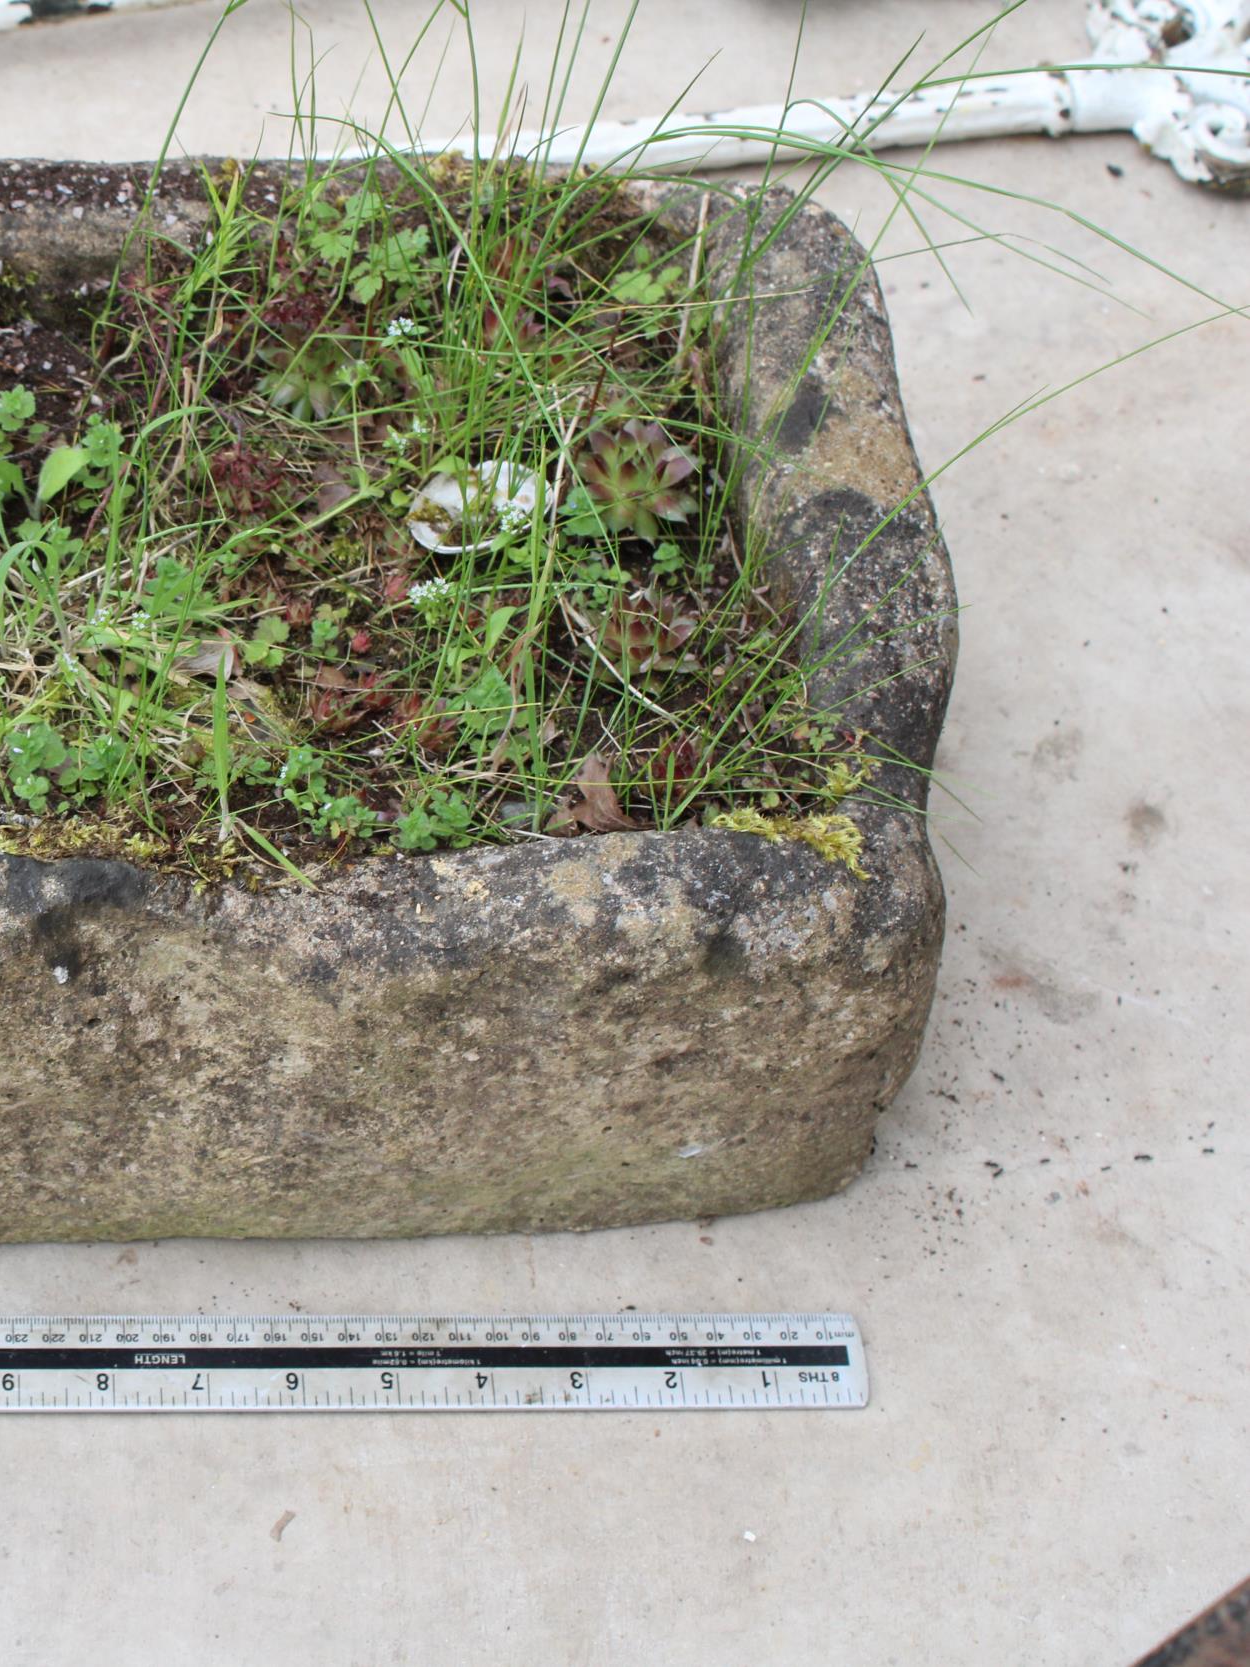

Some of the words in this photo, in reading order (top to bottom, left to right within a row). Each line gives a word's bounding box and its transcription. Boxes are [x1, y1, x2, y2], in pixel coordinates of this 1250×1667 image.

[135, 1355, 185, 1364] LENGTH
[2, 1374, 14, 1391] 9
[97, 1374, 109, 1390] 8
[192, 1374, 204, 1390] 7
[286, 1373, 298, 1389] 6
[381, 1373, 393, 1389] 5
[476, 1373, 488, 1389] 4
[570, 1372, 583, 1388] 3
[664, 1372, 677, 1388] 2
[761, 1372, 771, 1386] 1
[799, 1372, 828, 1382] THS
[831, 1372, 840, 1382] 8
